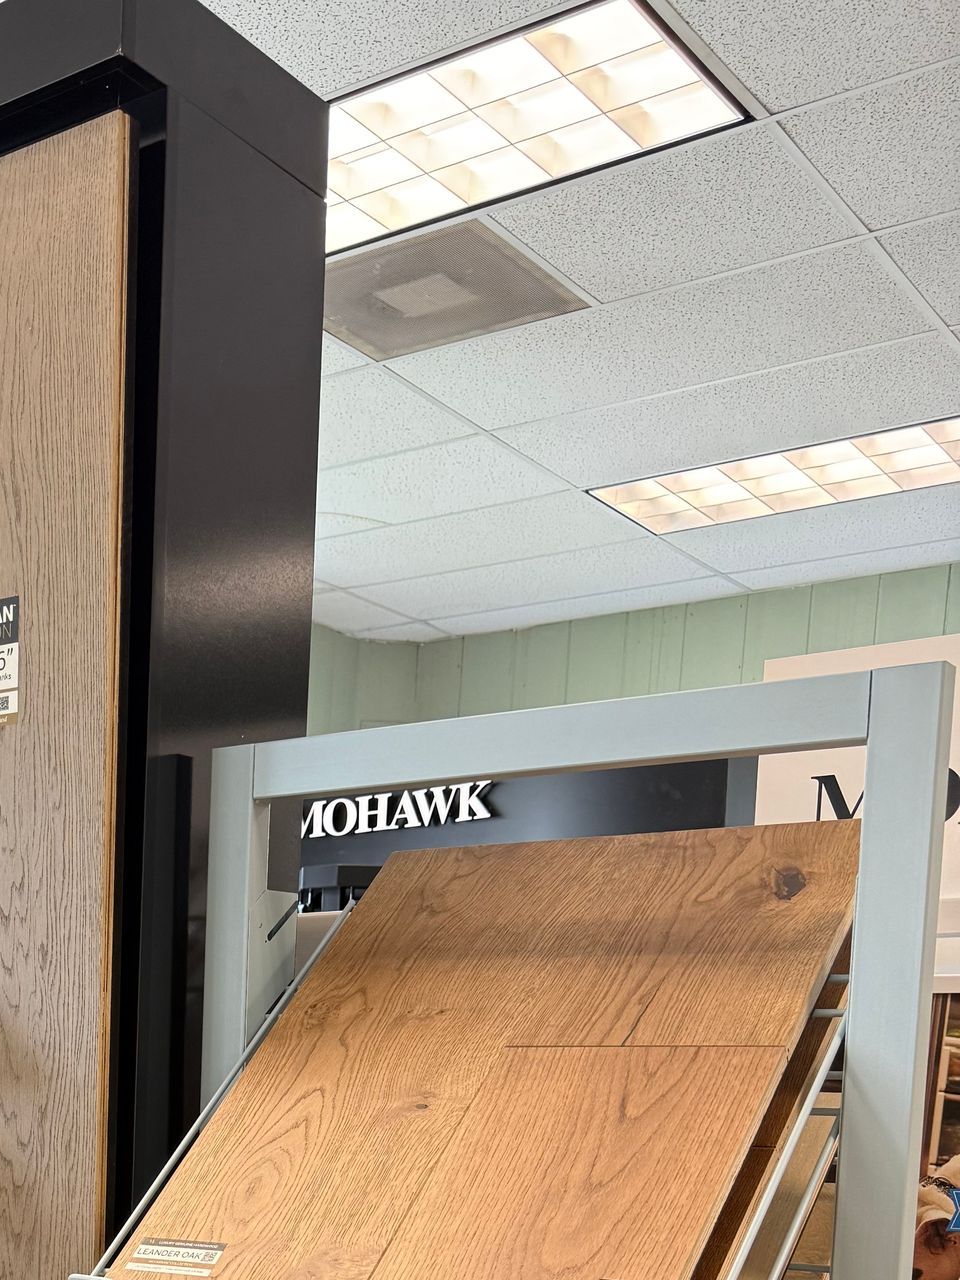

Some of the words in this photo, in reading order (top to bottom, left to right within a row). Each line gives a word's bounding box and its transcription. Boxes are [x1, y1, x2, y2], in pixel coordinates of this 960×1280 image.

[301, 779, 492, 839] MOHAWK
[137, 1248, 179, 1258] LEANDER
[181, 1251, 201, 1260] OAK
